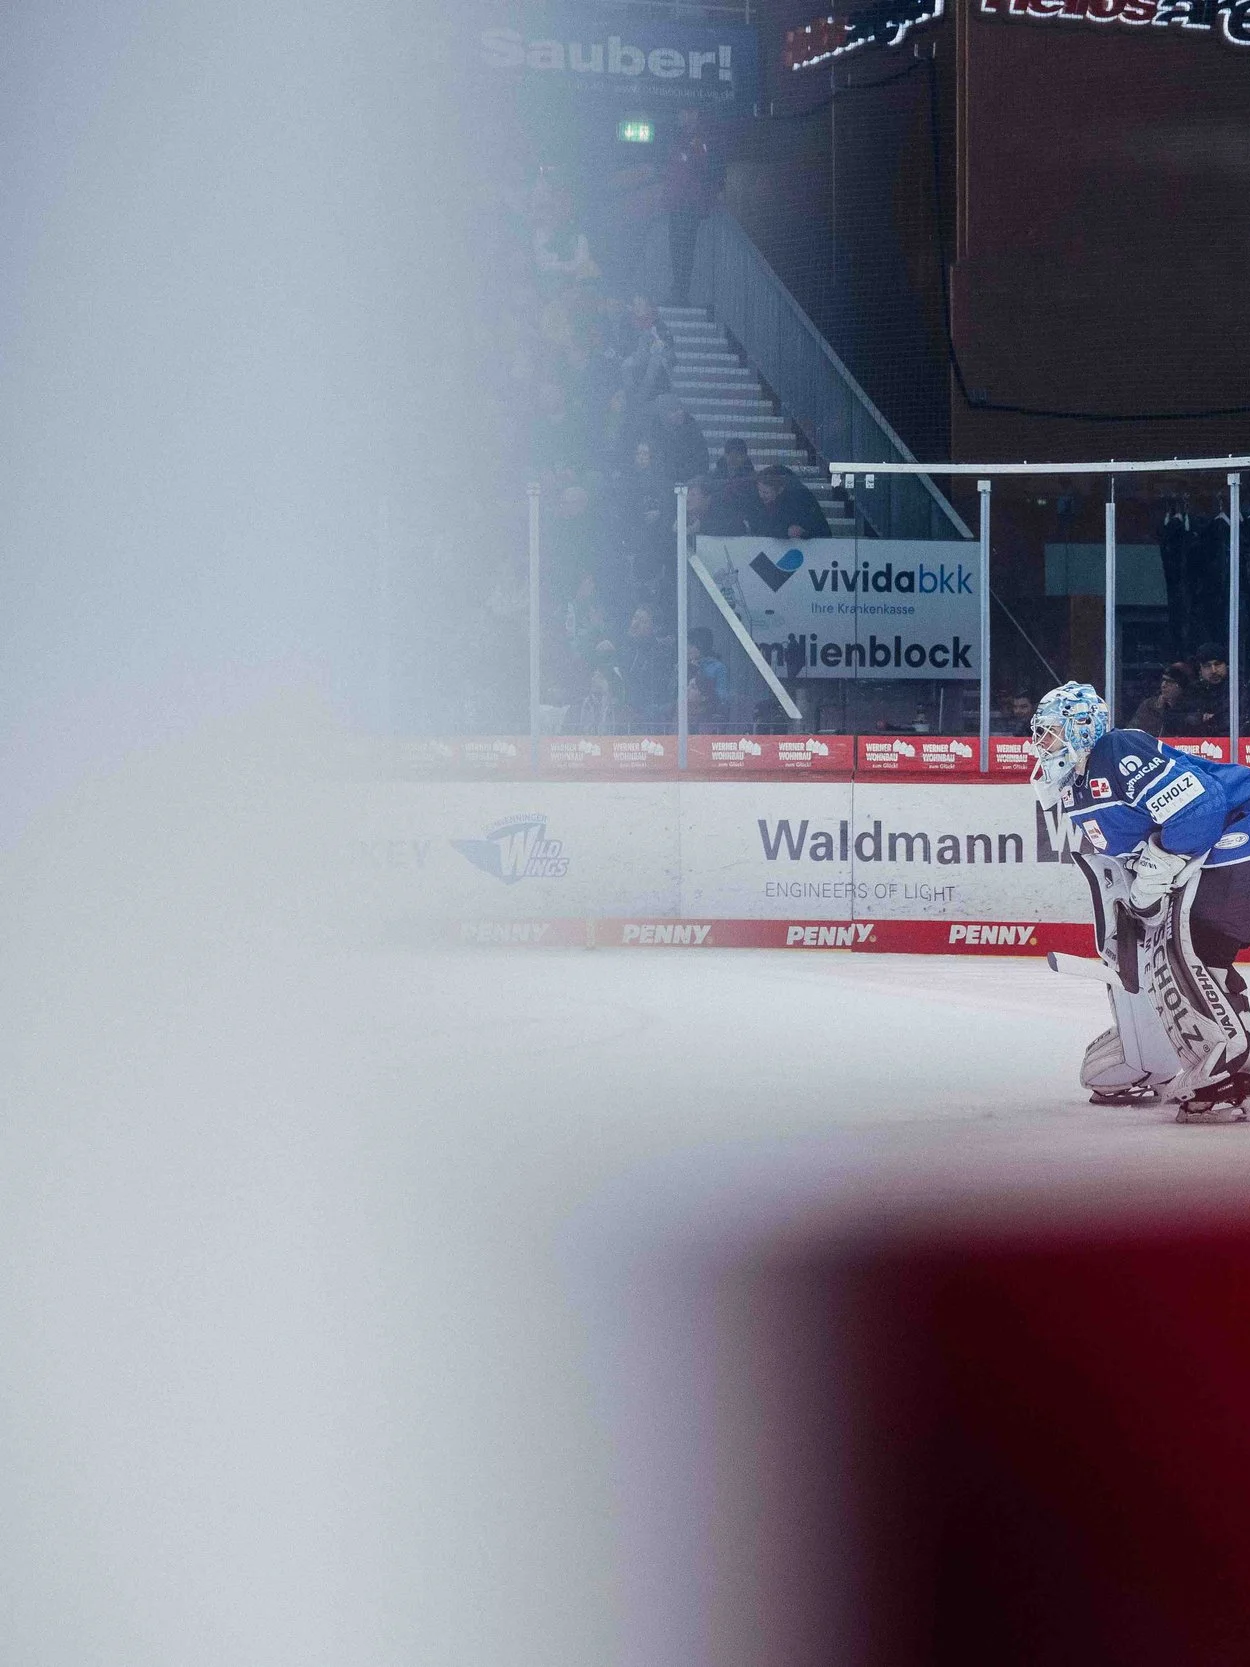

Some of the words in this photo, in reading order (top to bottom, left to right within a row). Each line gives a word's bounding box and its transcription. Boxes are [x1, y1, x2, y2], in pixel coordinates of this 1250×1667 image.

[480, 27, 732, 81] Sauber!
[811, 603, 834, 615] Ihre
[837, 603, 915, 615] Krankenkasse
[779, 743, 804, 751] WERNER
[866, 743, 891, 752] WERNER
[923, 744, 948, 753] WERNER
[996, 744, 1021, 753] WERNER
[866, 753, 898, 761] WOHNBAU
[923, 753, 955, 762] WOHNBAU
[997, 754, 1027, 763] WOHNBAU
[1150, 776, 1194, 812] SCHOLZ
[757, 818, 1024, 864] Waldmann
[765, 882, 868, 899] ENGINEERS
[875, 883, 898, 899] OF
[904, 884, 956, 902] LIGHT
[1152, 926, 1205, 1050] SCHOLZ
[1191, 964, 1238, 1040] VAUGHN
